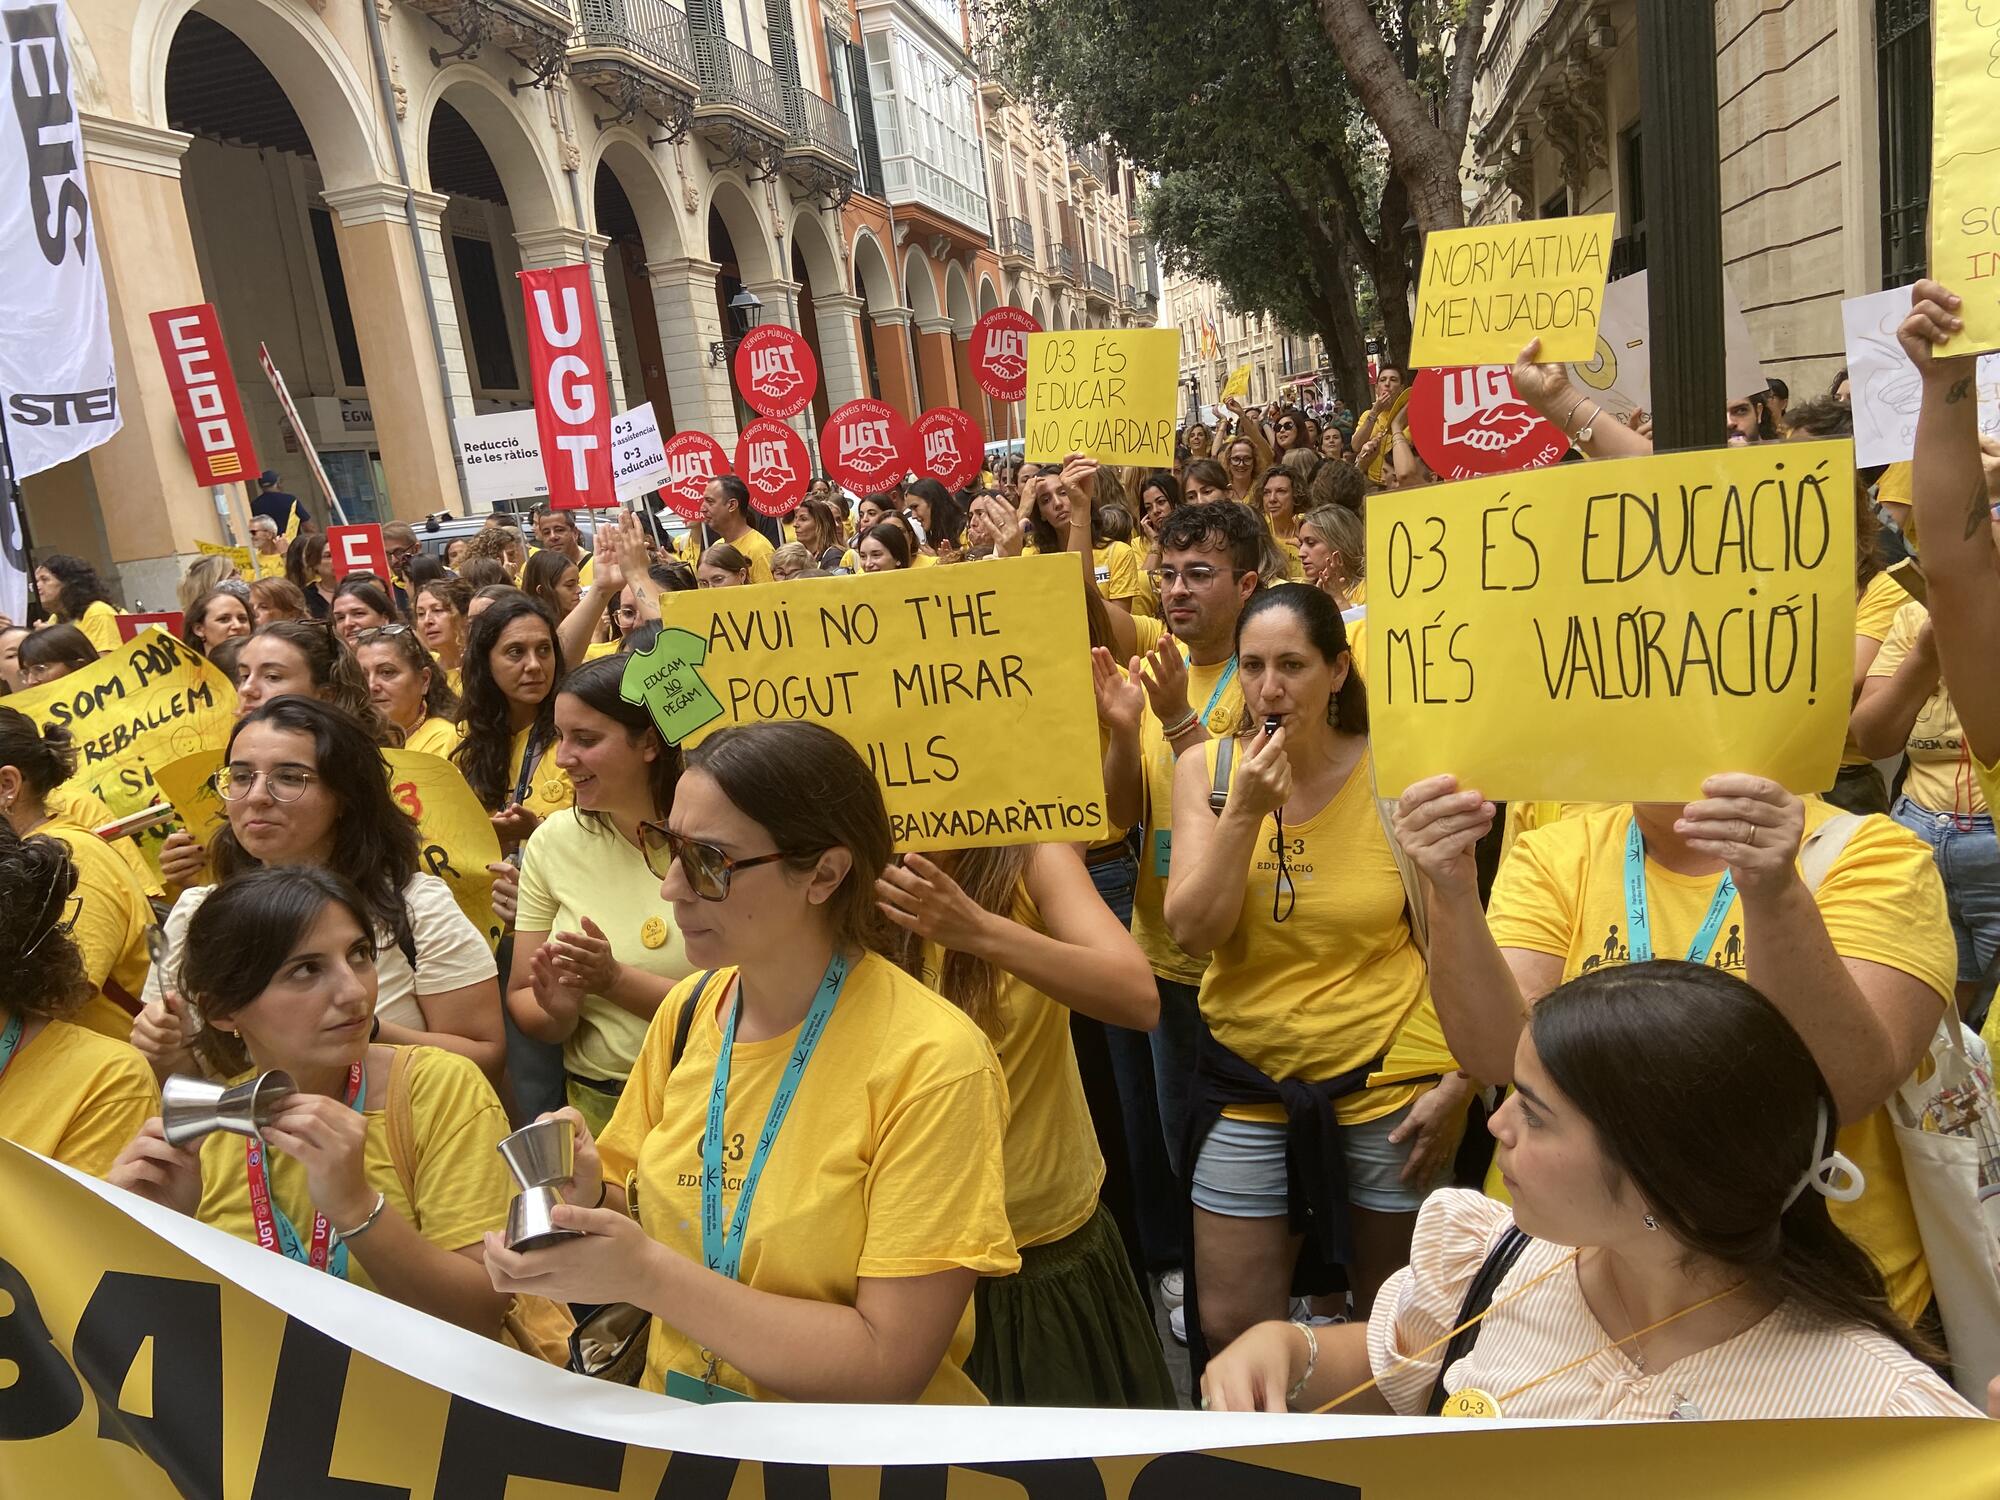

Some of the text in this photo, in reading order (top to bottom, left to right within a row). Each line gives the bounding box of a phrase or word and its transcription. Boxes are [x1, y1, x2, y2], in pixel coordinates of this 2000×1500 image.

[1429, 232, 1603, 287] NORMATIVA
[983, 311, 1008, 327] SERVEIS
[1422, 287, 1596, 337] MENJADOR
[744, 331, 766, 350] SERVEIS
[1094, 336, 1127, 373] ÉS
[751, 345, 795, 379] UGT
[168, 315, 236, 452] CCOO
[534, 287, 598, 491] UGT
[982, 380, 1000, 397] ILLES
[1036, 378, 1127, 411] EDUCAR
[1444, 366, 1512, 425] UG
[757, 396, 806, 417] ILLES BALEARS
[833, 402, 892, 425] SERVEIS PÚBLICS
[615, 421, 632, 434] 0-3
[617, 425, 656, 445] assistencial
[840, 419, 891, 454] UGT
[919, 415, 934, 434] SERVEIS
[1030, 418, 1172, 457] NO GUARDAR
[464, 438, 519, 452] Reducció
[467, 449, 539, 465] de les ràtios
[623, 447, 641, 460] 0-3
[749, 440, 789, 473] UGT
[924, 428, 957, 460] UGT
[621, 453, 663, 476] educatiu
[672, 451, 715, 483] UGT
[842, 472, 900, 493] ILLES BALEARS
[945, 475, 964, 494] ALEARS
[675, 504, 692, 518] ILLES
[751, 494, 797, 514] ILLES BALEARS
[1388, 516, 1448, 598] 0-3
[1481, 491, 1539, 592] ÉS
[819, 603, 879, 648] NO
[905, 590, 1000, 640] T'HE
[1387, 610, 1474, 705] MÉS
[643, 658, 686, 690] EDUCAM
[663, 679, 682, 695] NO
[728, 655, 1033, 721] POGUT MIRAR
[50, 675, 125, 727] SOM
[663, 688, 702, 717] PEGAM
[80, 681, 213, 765] REBALLEM
[1257, 862, 1313, 873] EDUACIÓ
[1460, 1399, 1484, 1415] 0-3
